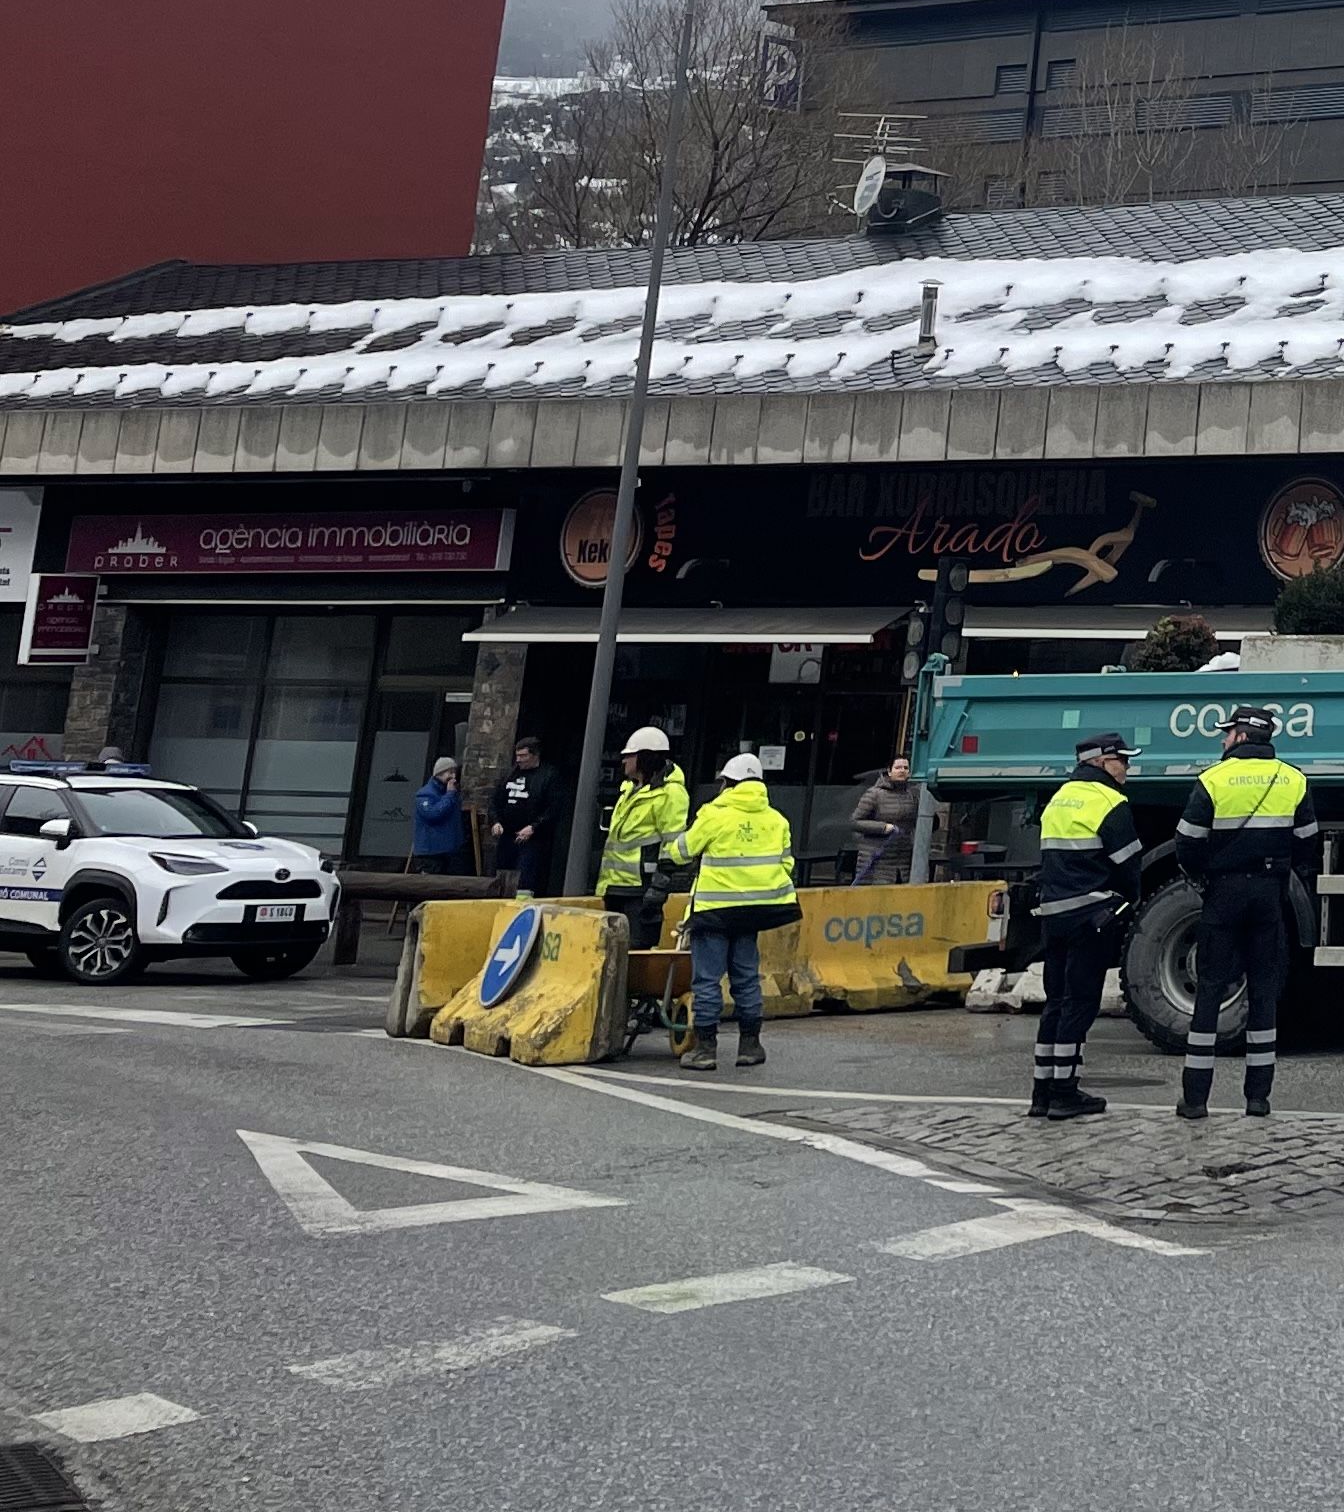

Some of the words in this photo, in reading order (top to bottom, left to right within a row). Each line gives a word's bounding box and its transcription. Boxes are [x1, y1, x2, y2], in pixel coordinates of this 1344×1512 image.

[805, 471, 866, 519] BAR
[858, 496, 1047, 563] Arado
[576, 539, 612, 564] Kek
[1169, 701, 1314, 738] cosa
[9, 888, 49, 901] COMUNAL
[824, 911, 925, 949] copsa
